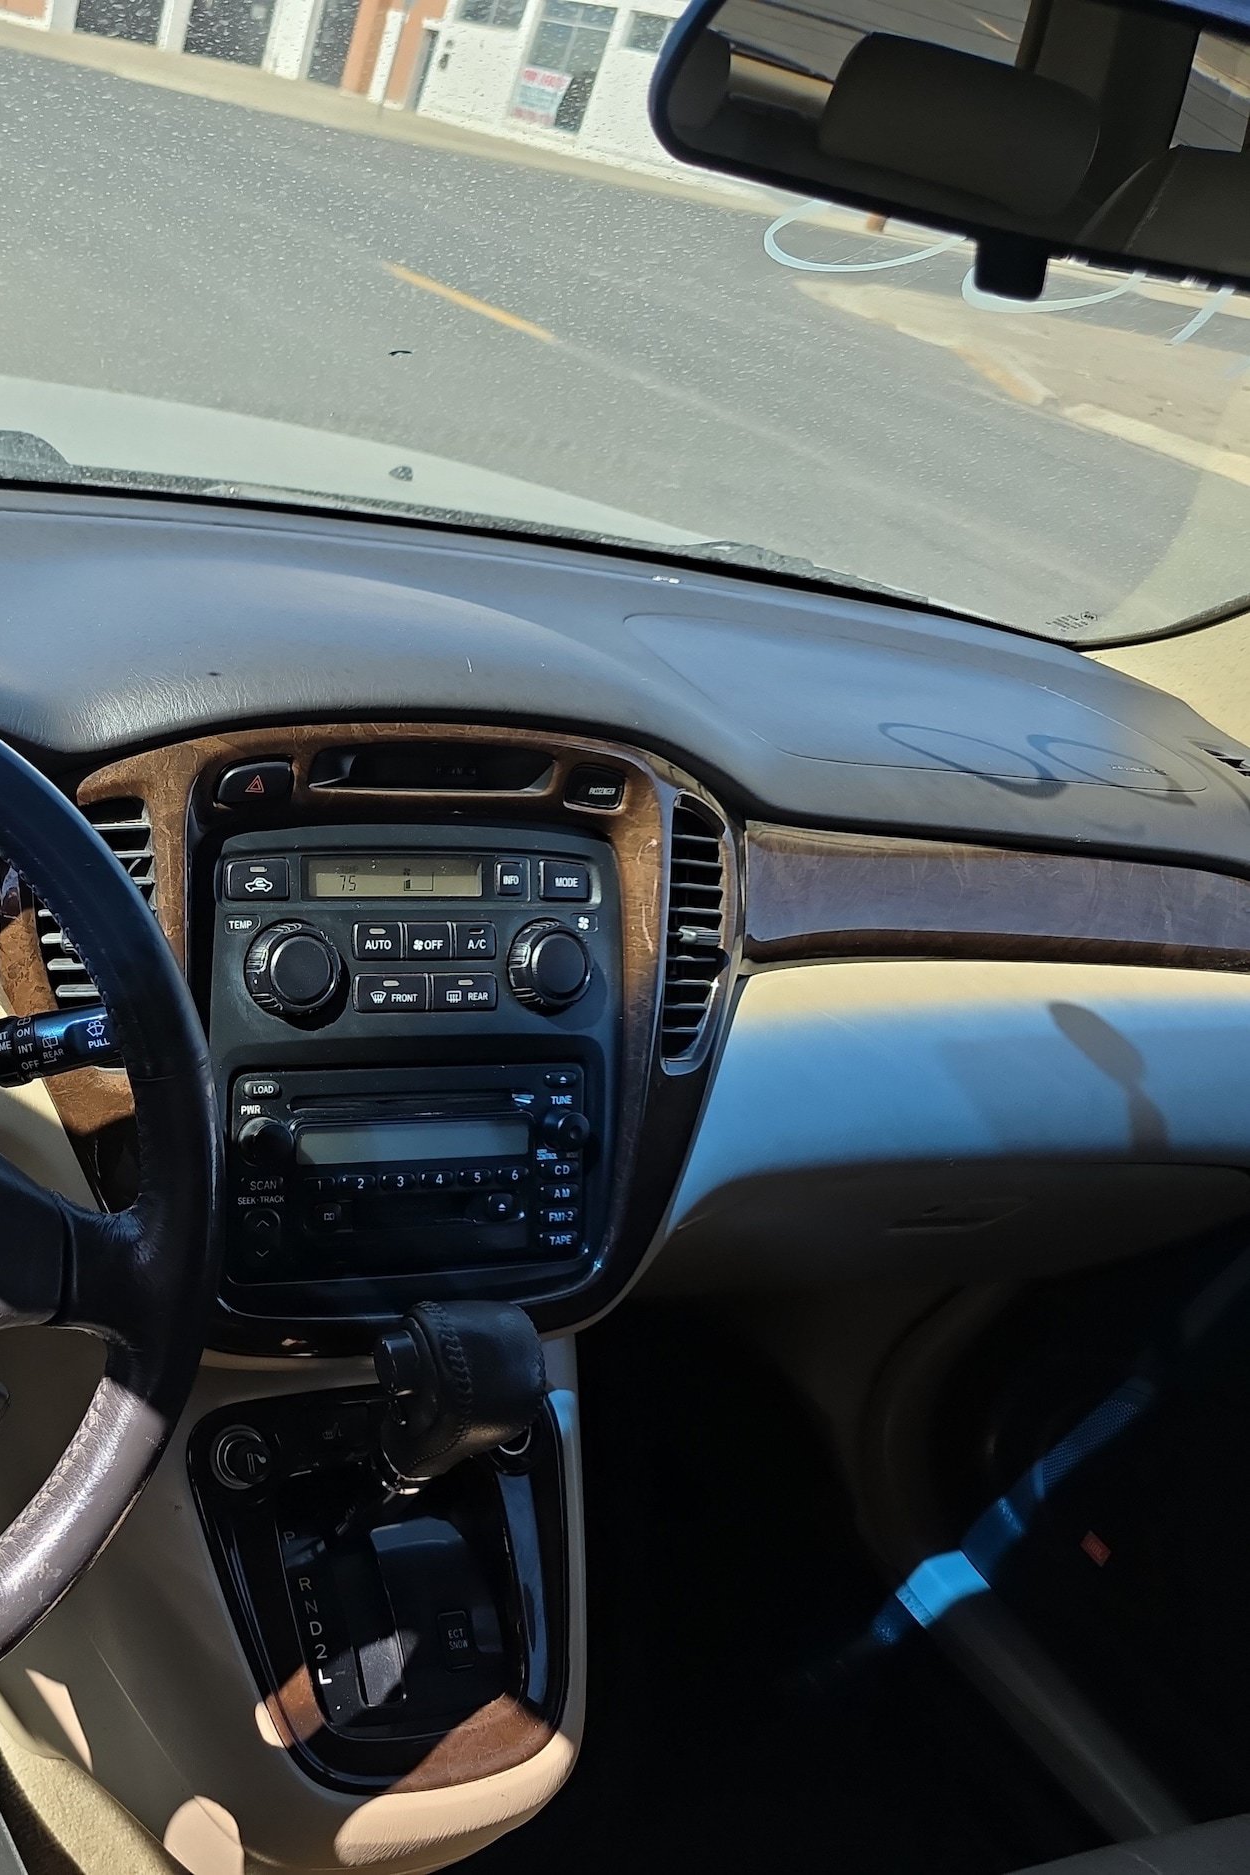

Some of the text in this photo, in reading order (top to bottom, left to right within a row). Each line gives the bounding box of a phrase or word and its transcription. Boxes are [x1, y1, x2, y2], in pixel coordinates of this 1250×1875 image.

[340, 875, 357, 892] 75
[503, 875, 519, 886] INFO
[555, 877, 579, 888] MODE
[229, 920, 252, 930] TEMP
[364, 940, 392, 950] AUTO
[424, 940, 443, 950] OFF
[468, 939, 486, 950] A/C
[391, 993, 418, 1003] FRONT
[468, 992, 488, 1001] REAR
[16, 1027, 31, 1038] ON
[18, 1043, 33, 1054] INT
[88, 1038, 110, 1050] PULL
[42, 1048, 64, 1060] REAR
[21, 1060, 40, 1071] OFF
[253, 1086, 274, 1094] LOAD
[550, 1095, 572, 1105] TUNE
[240, 1105, 262, 1115] PWR
[512, 1170, 518, 1180] 6
[554, 1164, 570, 1176] CD
[396, 1176, 404, 1188] 3
[435, 1174, 444, 1184] 4
[474, 1172, 482, 1183] 5
[250, 1180, 277, 1190] SCAN
[317, 1180, 322, 1191] 1
[357, 1178, 365, 1190] 2
[554, 1188, 570, 1198] AM
[550, 1234, 572, 1246] TAPE
[284, 1530, 296, 1545] P
[298, 1577, 312, 1592] R
[304, 1600, 319, 1615] N
[310, 1621, 323, 1636] D
[448, 1628, 463, 1639] ECT
[448, 1640, 468, 1650] SNOW
[314, 1644, 328, 1660] 2
[318, 1668, 332, 1686] L
